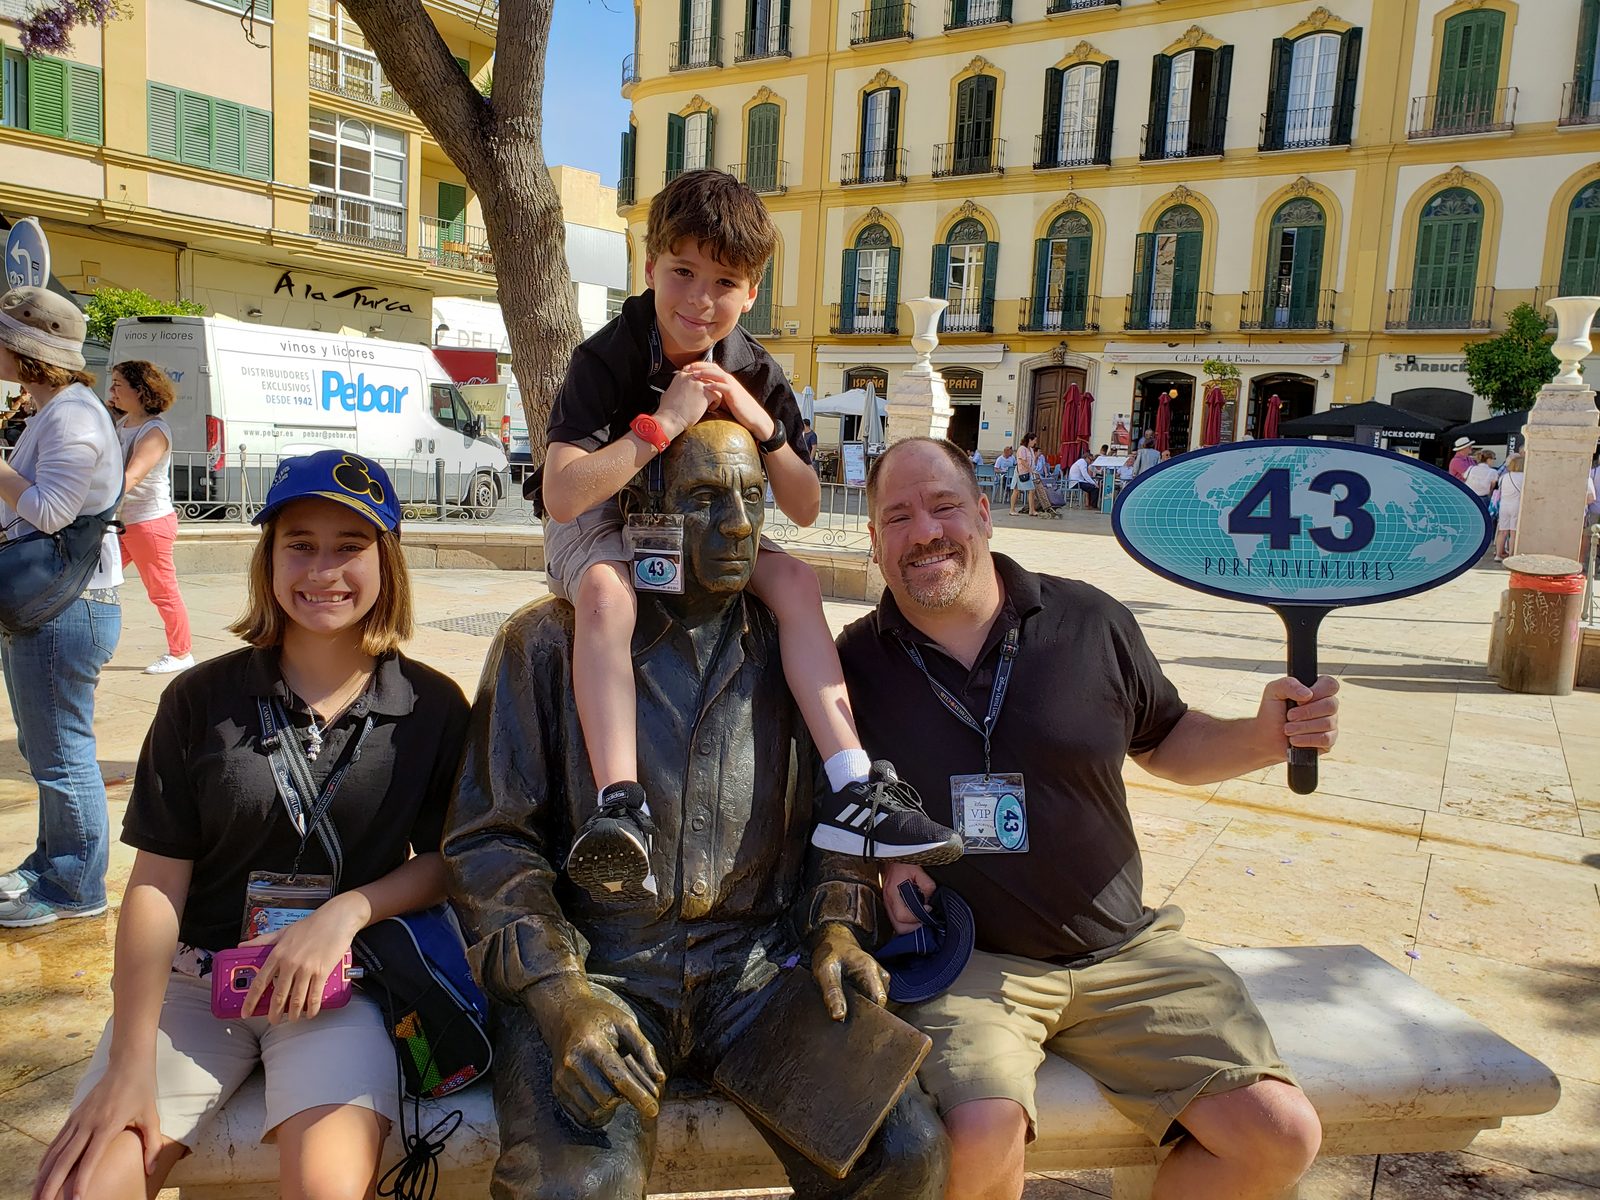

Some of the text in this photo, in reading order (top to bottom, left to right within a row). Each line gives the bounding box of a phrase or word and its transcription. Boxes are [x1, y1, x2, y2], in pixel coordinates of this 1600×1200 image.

[274, 270, 413, 313] A la Turca
[124, 330, 194, 342] vinos y licores
[280, 340, 375, 360] vinos y licores
[241, 366, 309, 381] DISTRIBUIDORES
[1394, 363, 1469, 372] STARBUCK
[262, 381, 311, 392] EXCLUSIVOS
[321, 370, 409, 413] Pebar
[266, 394, 313, 406] DESDE 1942
[1382, 430, 1436, 440] UCKS COFFEE
[1228, 467, 1376, 554] 43
[648, 561, 665, 577] 43
[1204, 557, 1395, 581] PORT ADVENTURES
[971, 809, 991, 819] VIP
[1003, 809, 1019, 832] 43
